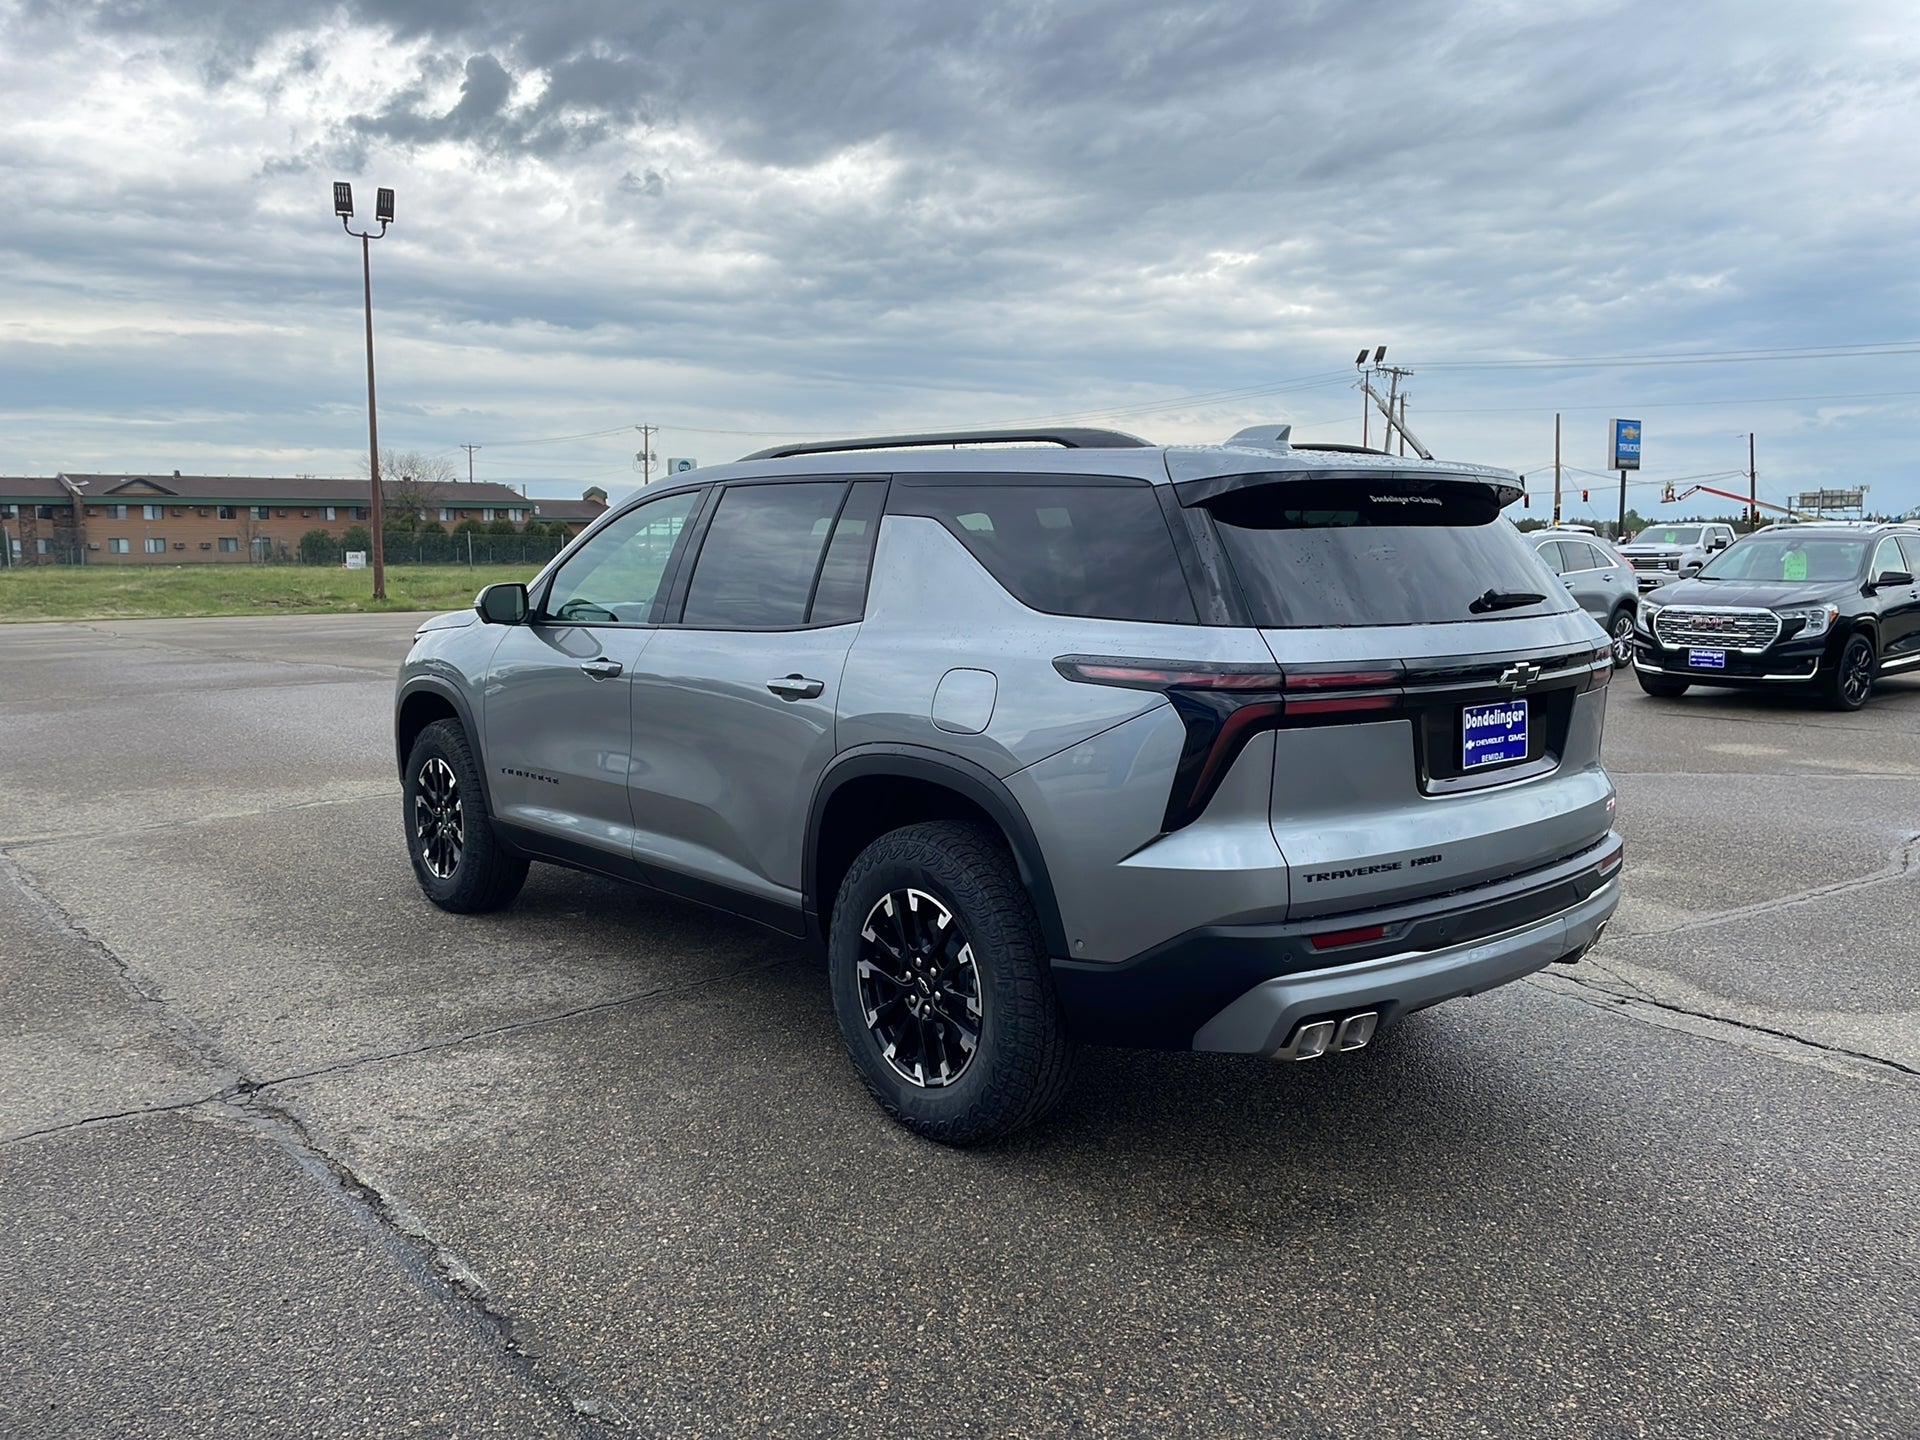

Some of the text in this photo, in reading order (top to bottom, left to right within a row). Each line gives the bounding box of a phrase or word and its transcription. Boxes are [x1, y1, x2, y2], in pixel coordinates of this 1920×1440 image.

[1690, 615, 1734, 631] GMC
[1465, 709, 1525, 730] Dondelinger
[1475, 733, 1526, 747] CHEVROLET GMC
[1481, 752, 1505, 763] BEMIDJI
[501, 768, 560, 784] TRAVERSE
[1303, 861, 1402, 883] TRAVERSE
